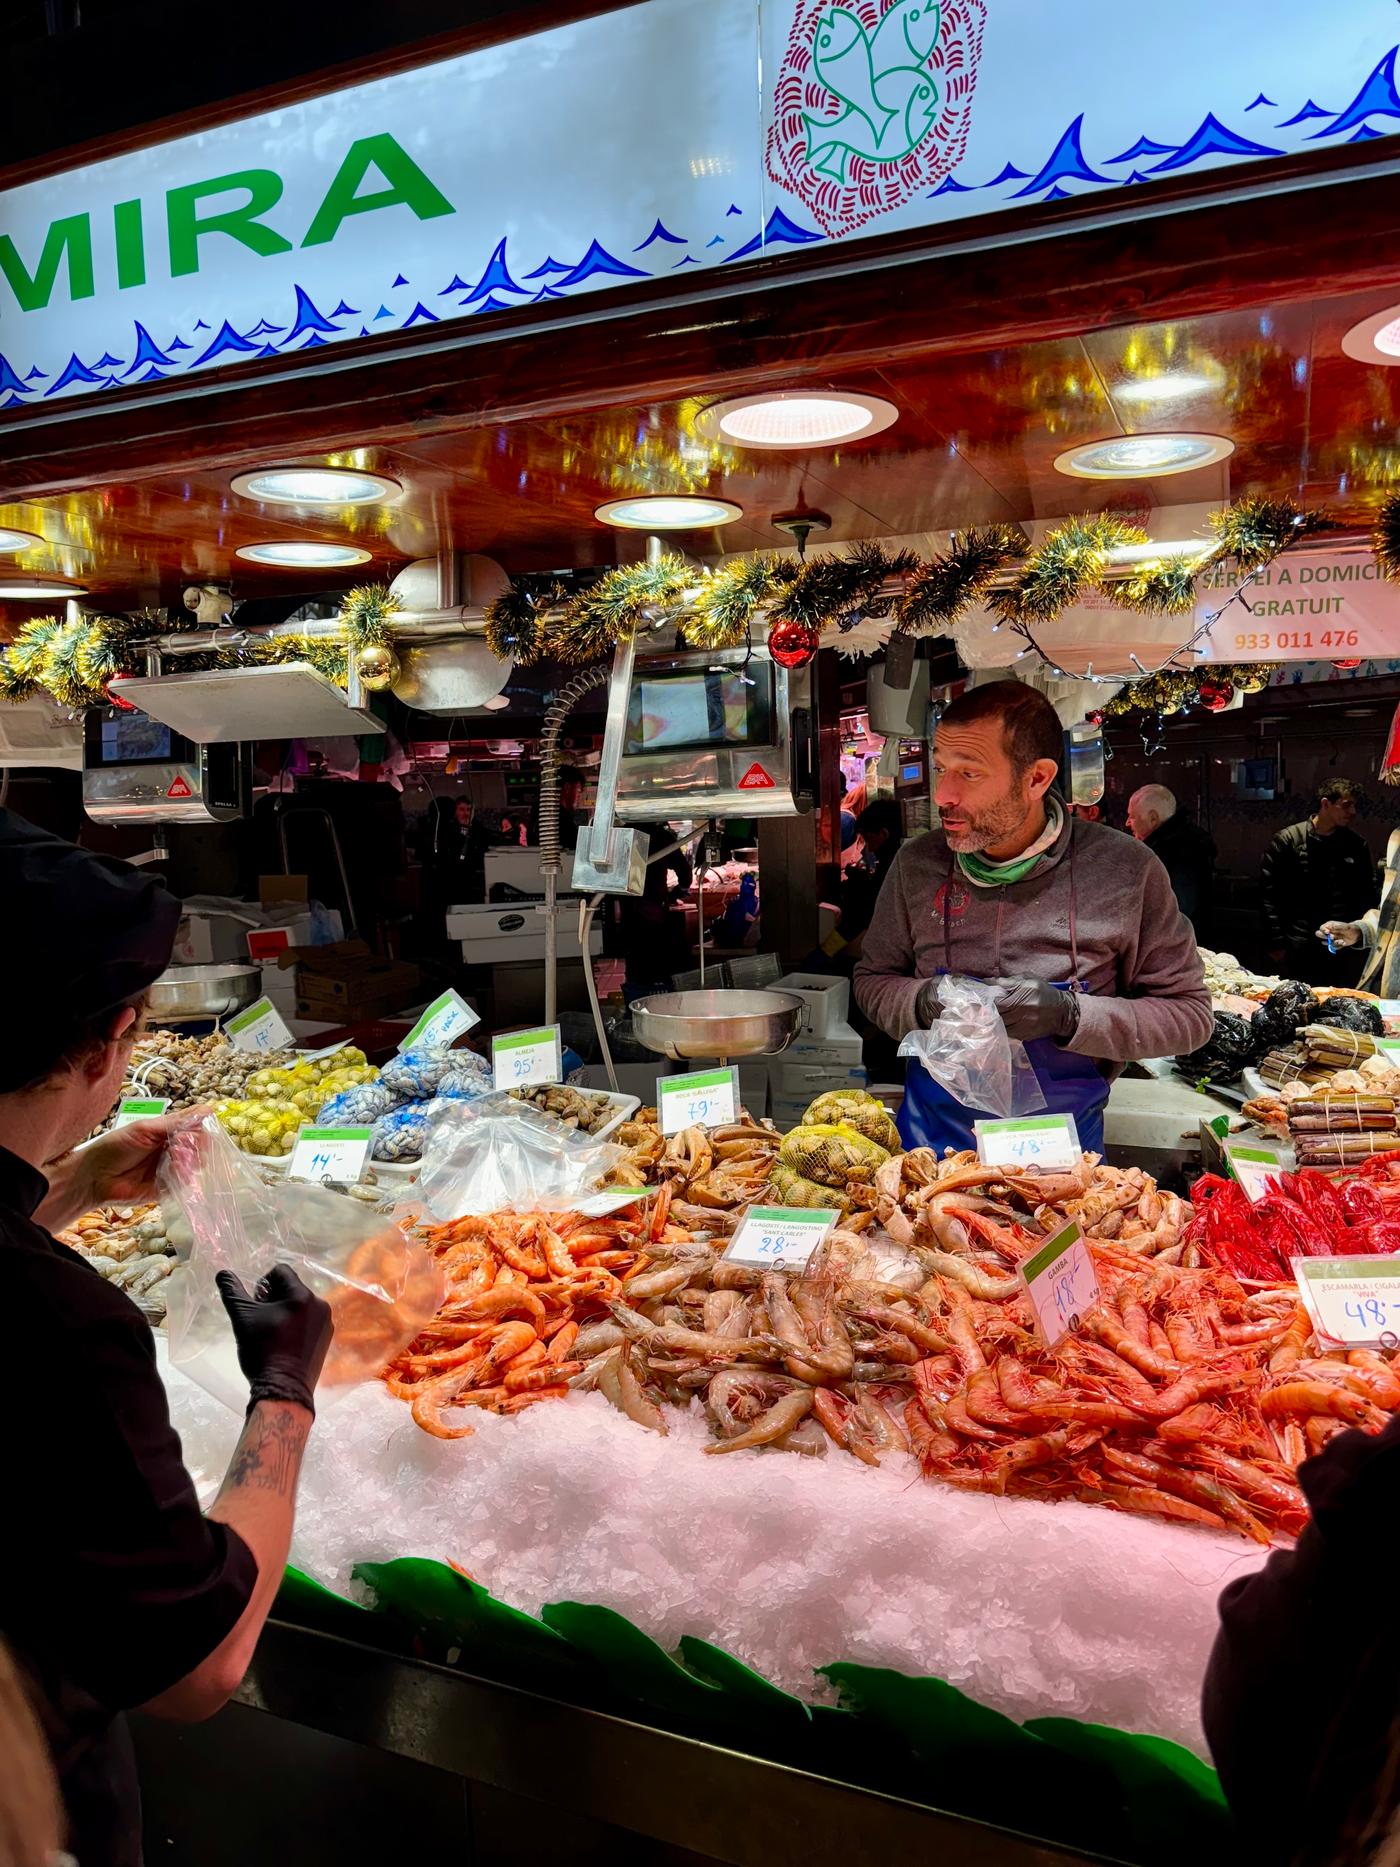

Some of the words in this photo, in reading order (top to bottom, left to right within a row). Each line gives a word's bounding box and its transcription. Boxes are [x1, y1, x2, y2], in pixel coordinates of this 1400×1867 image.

[0, 132, 457, 313] MIRA
[1277, 568, 1293, 585] A
[1253, 597, 1345, 617] GRATUIT
[1235, 632, 1271, 650] 933
[1277, 631, 1313, 649] 011
[1320, 629, 1359, 648] 476
[1047, 1258, 1069, 1280] GAMBA
